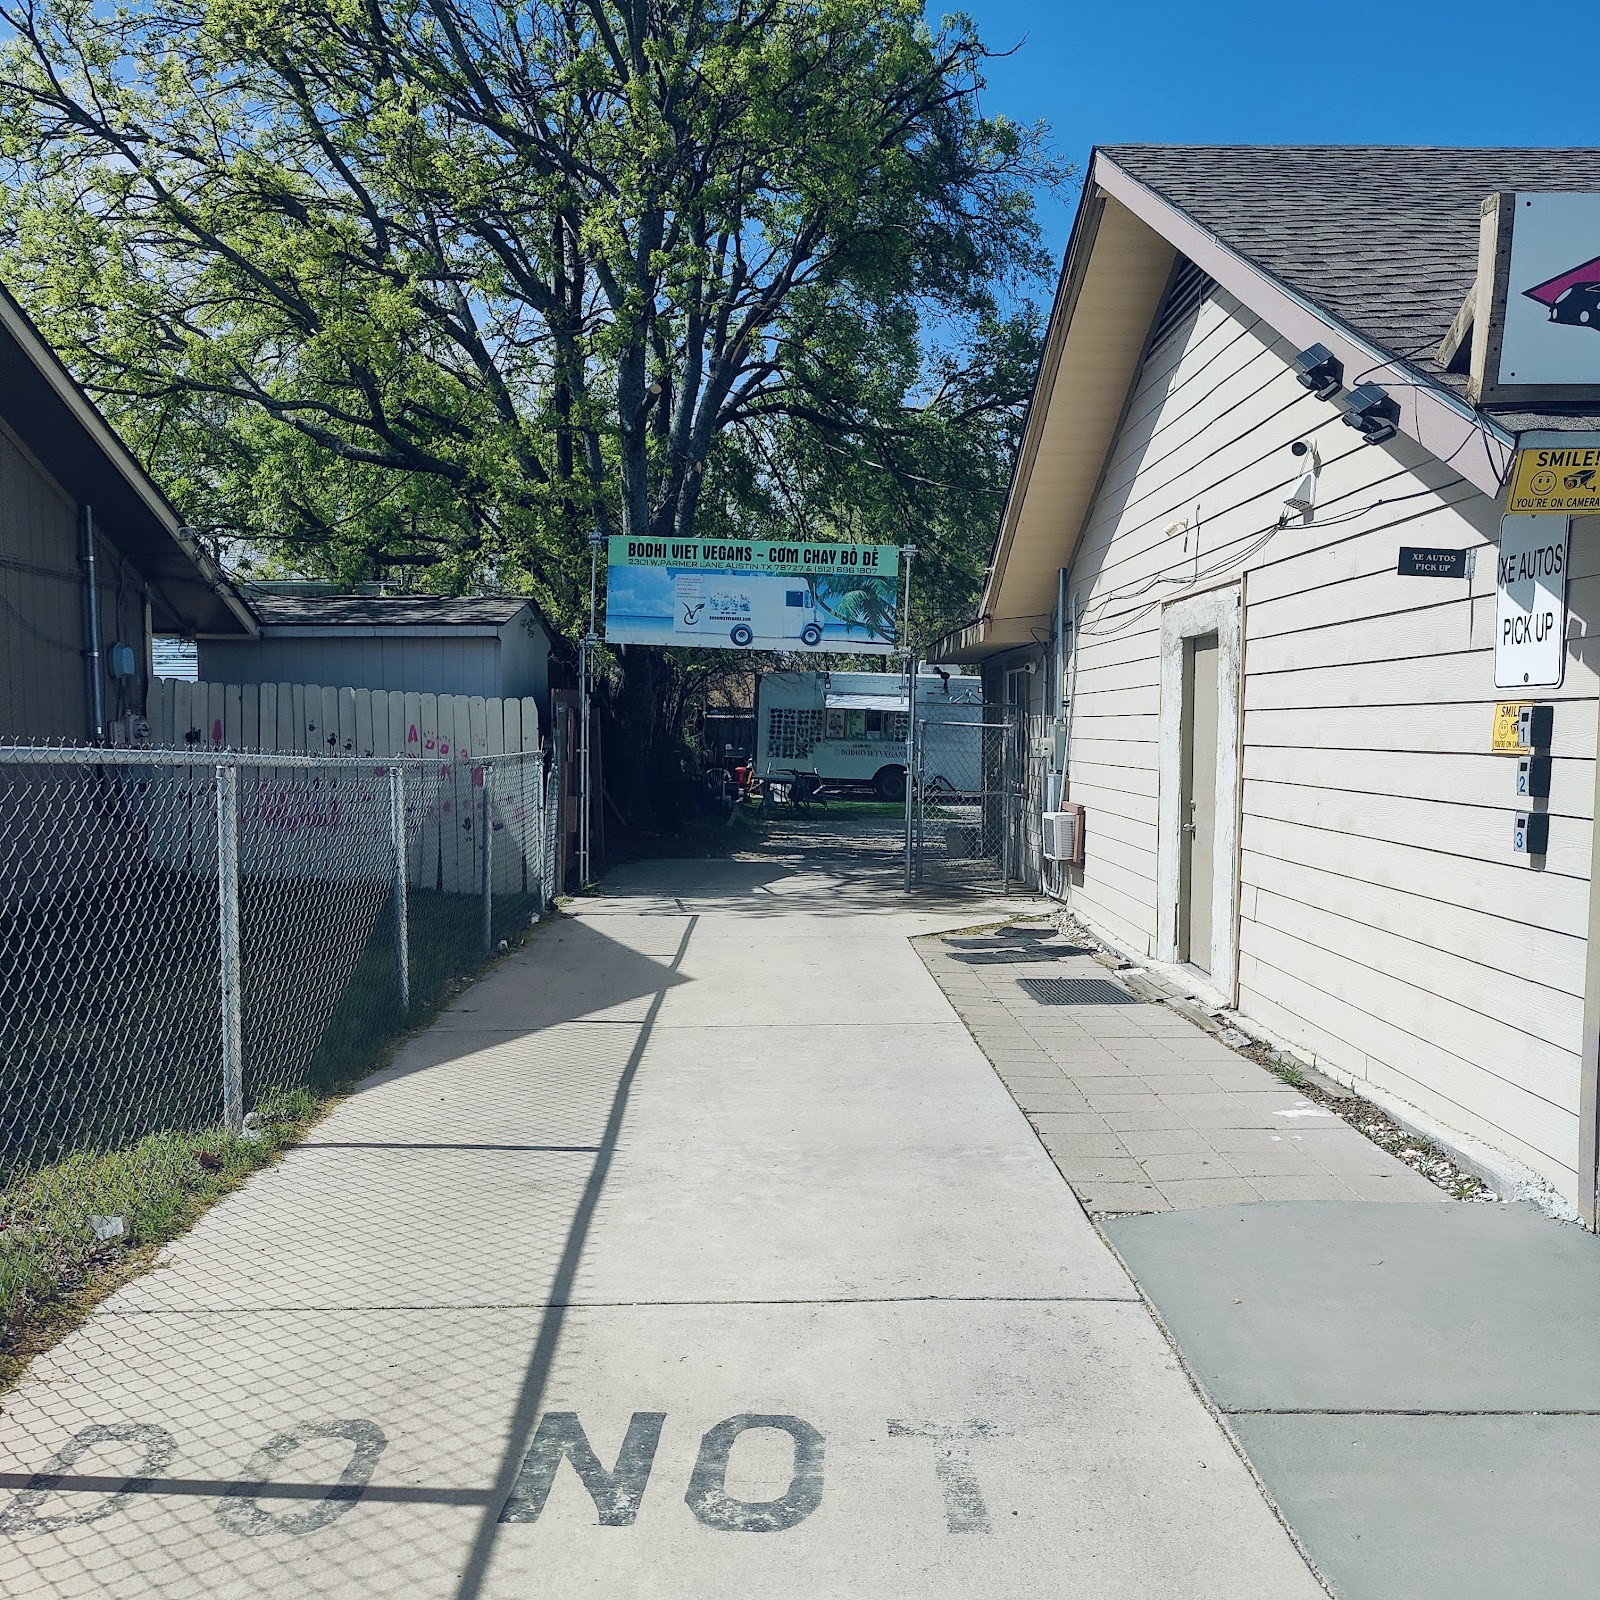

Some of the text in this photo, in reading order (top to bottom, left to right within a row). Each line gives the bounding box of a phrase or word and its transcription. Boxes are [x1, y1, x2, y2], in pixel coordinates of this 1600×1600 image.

[1536, 451, 1600, 467] SMILE!
[1517, 497, 1549, 508] YOU'RE
[1550, 497, 1564, 508] ON
[628, 542, 667, 559] BODHI
[671, 544, 699, 560] VIET
[702, 545, 753, 562] VEGANS
[769, 546, 799, 564] CƠM
[803, 548, 837, 565] CHAY
[841, 545, 858, 566] BỒ
[1411, 553, 1457, 563] XE AUTOS
[700, 561, 724, 569] LANE
[726, 562, 759, 570] AUSTIN
[761, 563, 772, 571] TX
[774, 564, 804, 572] 78727
[814, 565, 835, 574] (512)
[856, 567, 878, 575] 1807
[1415, 563, 1451, 572] PICK UP
[1500, 543, 1563, 585] XE AUTOS
[1503, 612, 1554, 646] PICK UP
[1520, 726, 1526, 743] 1
[1519, 775, 1526, 793] 2
[1516, 831, 1524, 849] 3
[497, 1411, 1012, 1536] NOT
